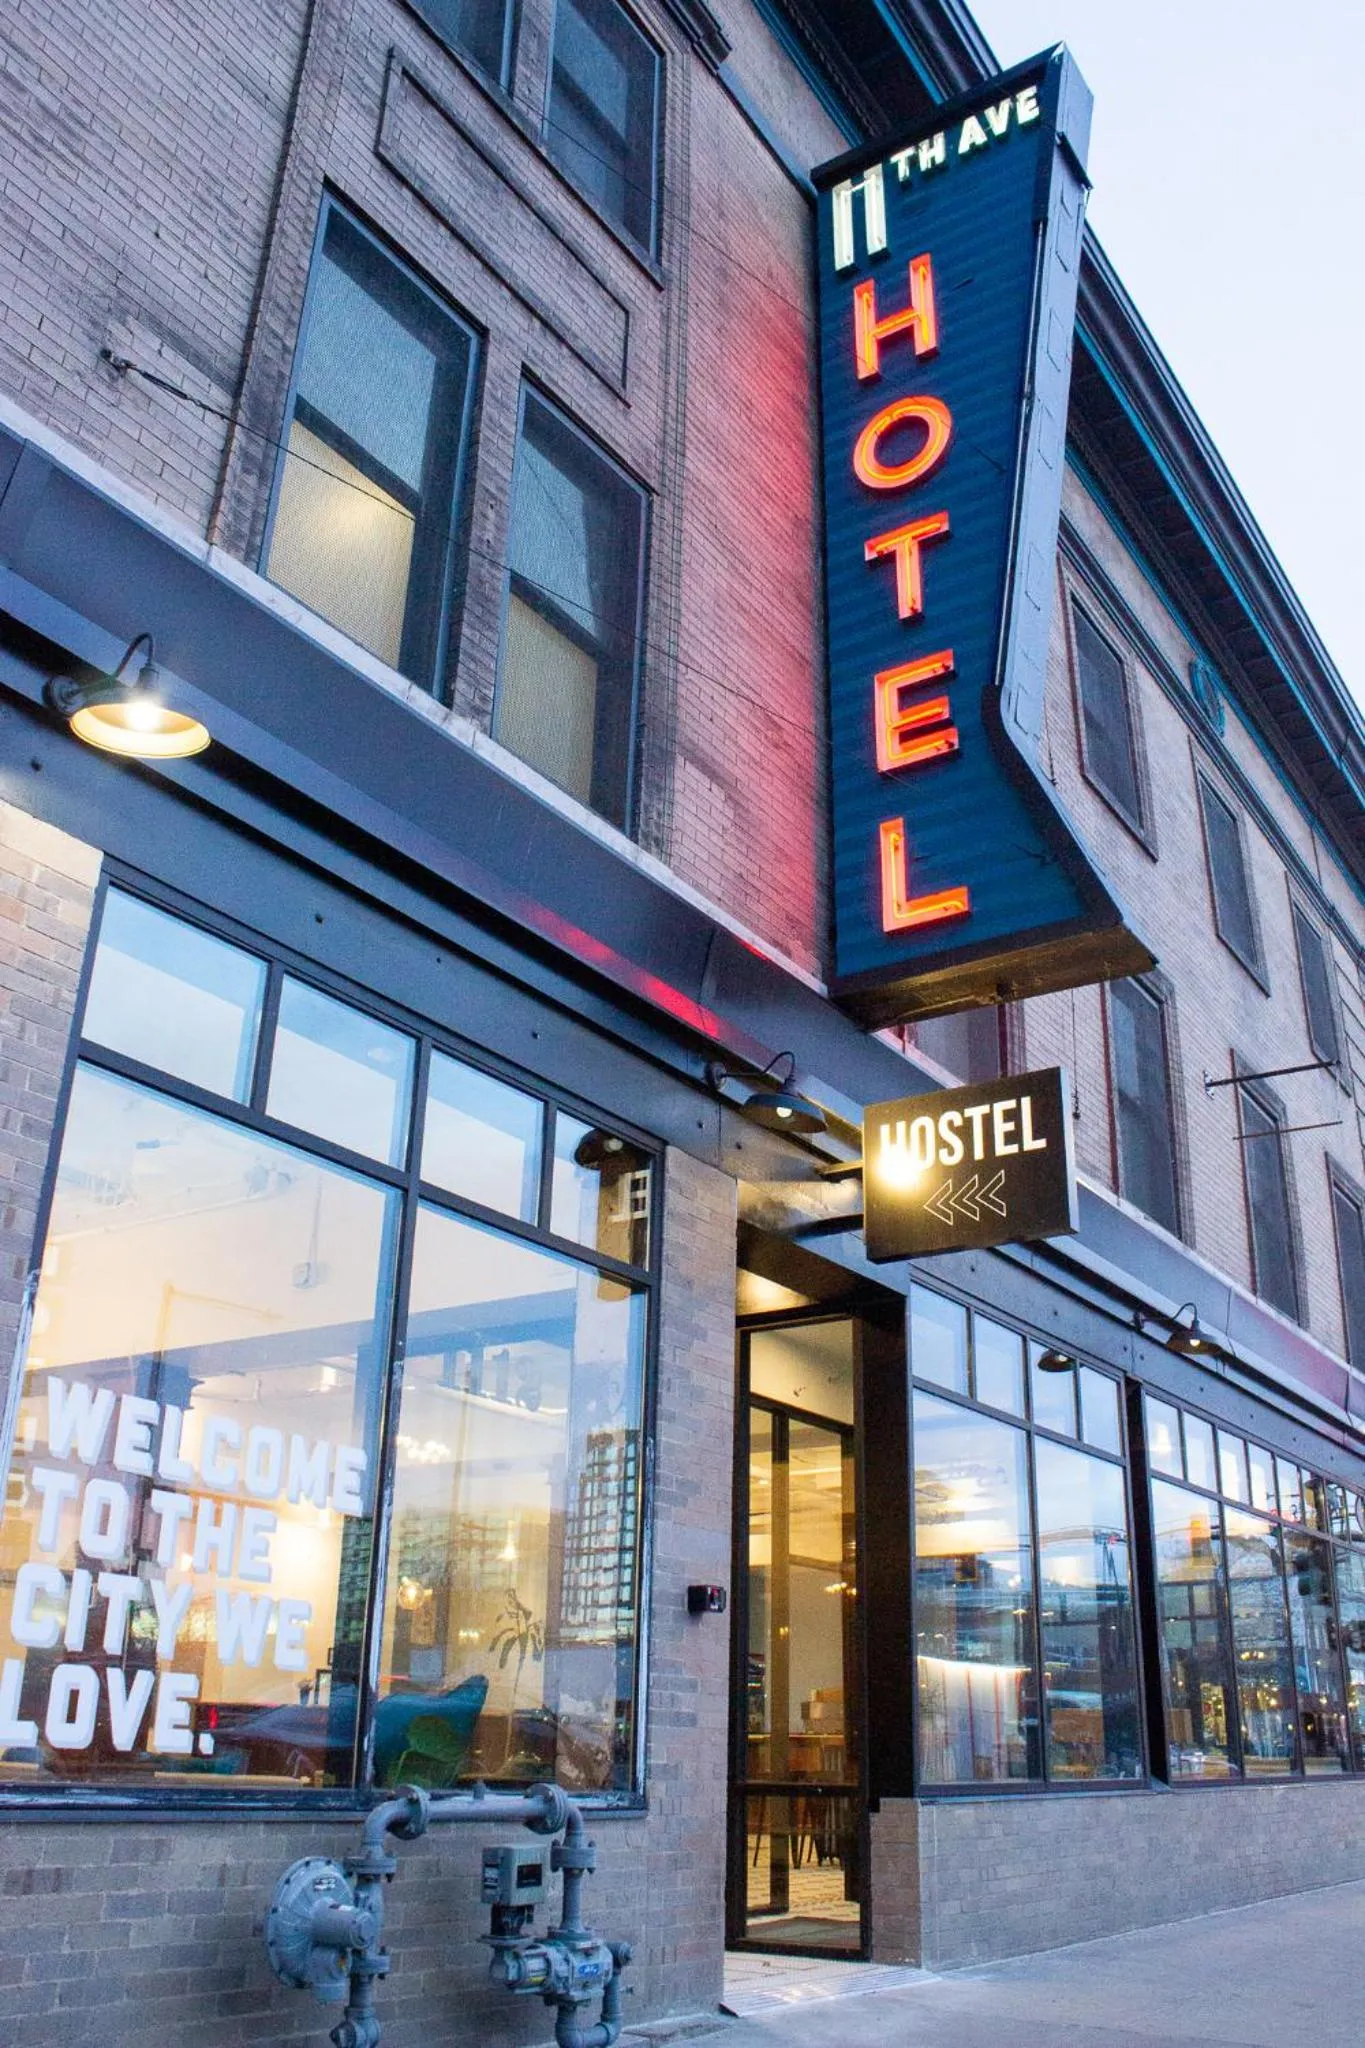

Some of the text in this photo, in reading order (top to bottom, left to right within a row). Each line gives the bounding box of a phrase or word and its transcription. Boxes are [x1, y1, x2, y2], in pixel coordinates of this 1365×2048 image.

[832, 86, 1040, 272] 11TH AVE
[853, 252, 970, 933] HOTEL
[879, 1096, 1048, 1173] HOSTEL
[47, 1376, 367, 1517] WELCOME
[32, 1466, 278, 1583] TO THE
[10, 1562, 313, 1673] CITY WE
[0, 1658, 215, 1755] LOVE.
